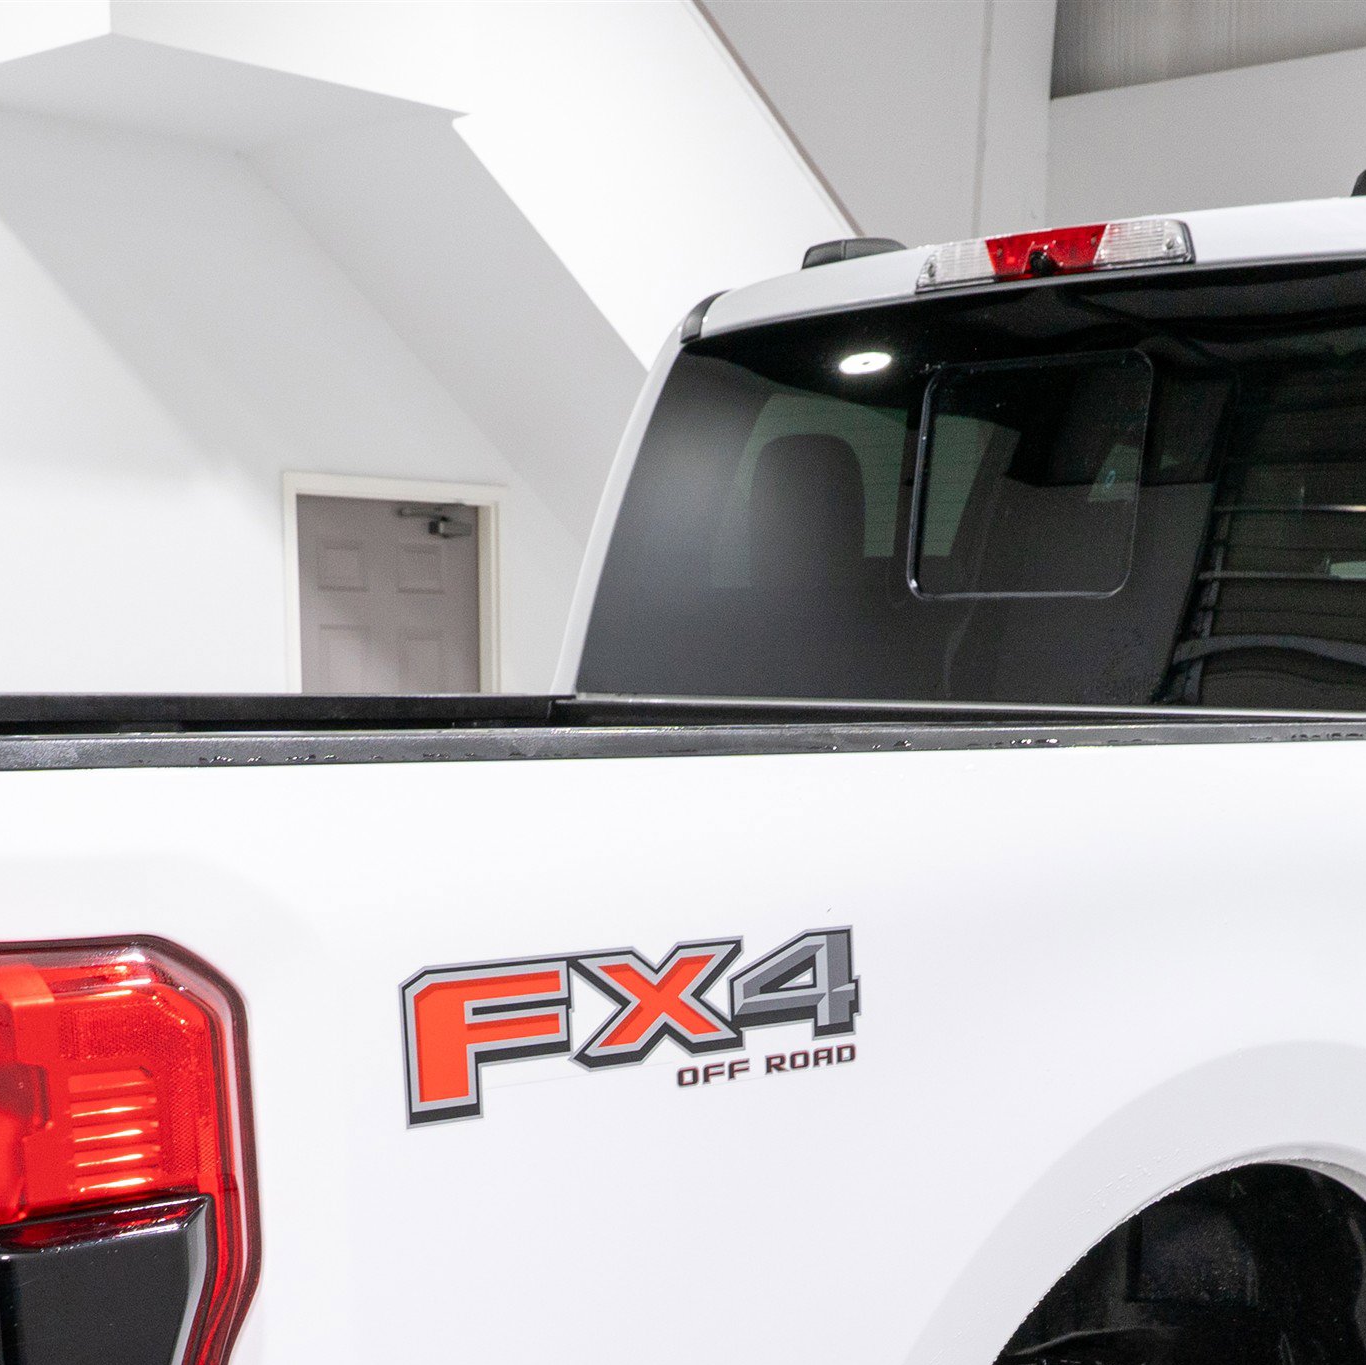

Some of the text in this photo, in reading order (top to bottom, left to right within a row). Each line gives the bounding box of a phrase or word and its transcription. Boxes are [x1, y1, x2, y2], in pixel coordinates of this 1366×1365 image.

[398, 925, 862, 1130] FX4
[675, 1043, 857, 1088] OFF ROAD
